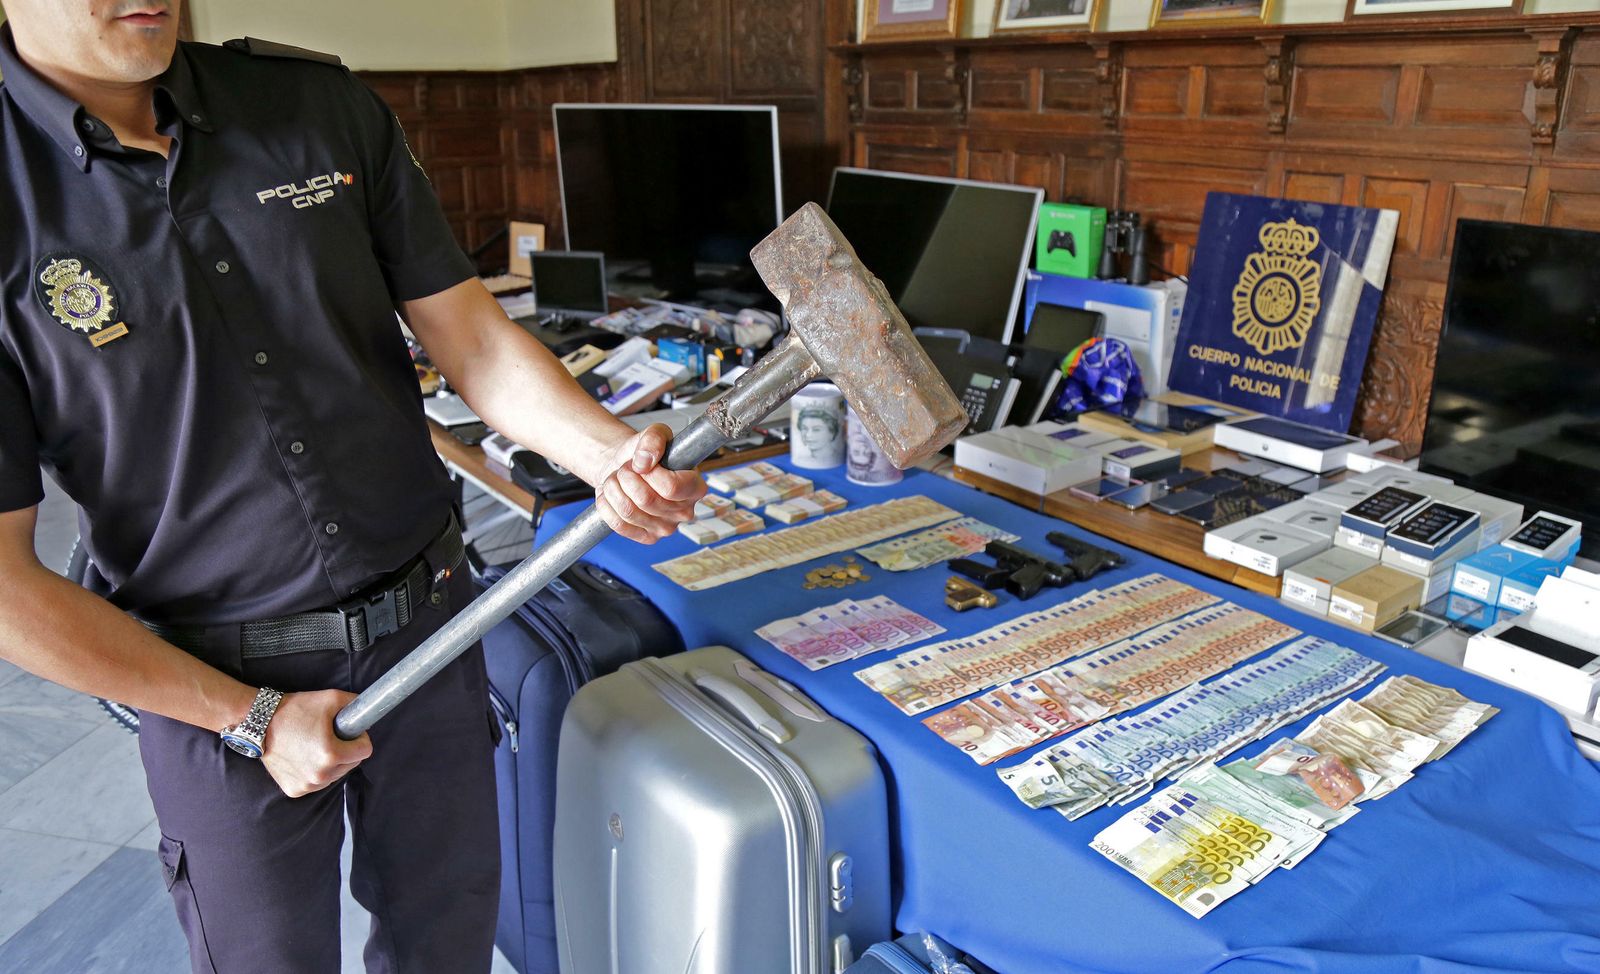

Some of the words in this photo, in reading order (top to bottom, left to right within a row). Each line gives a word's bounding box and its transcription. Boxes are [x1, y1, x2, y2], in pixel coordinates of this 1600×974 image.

[256, 171, 344, 204] POLICIA
[291, 189, 334, 209] CNP
[1189, 345, 1240, 367] CUERPO
[1244, 356, 1312, 384] NACIONAL
[1319, 373, 1341, 390] DE
[1229, 374, 1281, 399] POLICIA
[959, 741, 978, 751] 10
[1041, 775, 1059, 786] 5
[1103, 765, 1133, 782] 20
[1095, 840, 1115, 855] 200
[1186, 853, 1232, 885] 200
